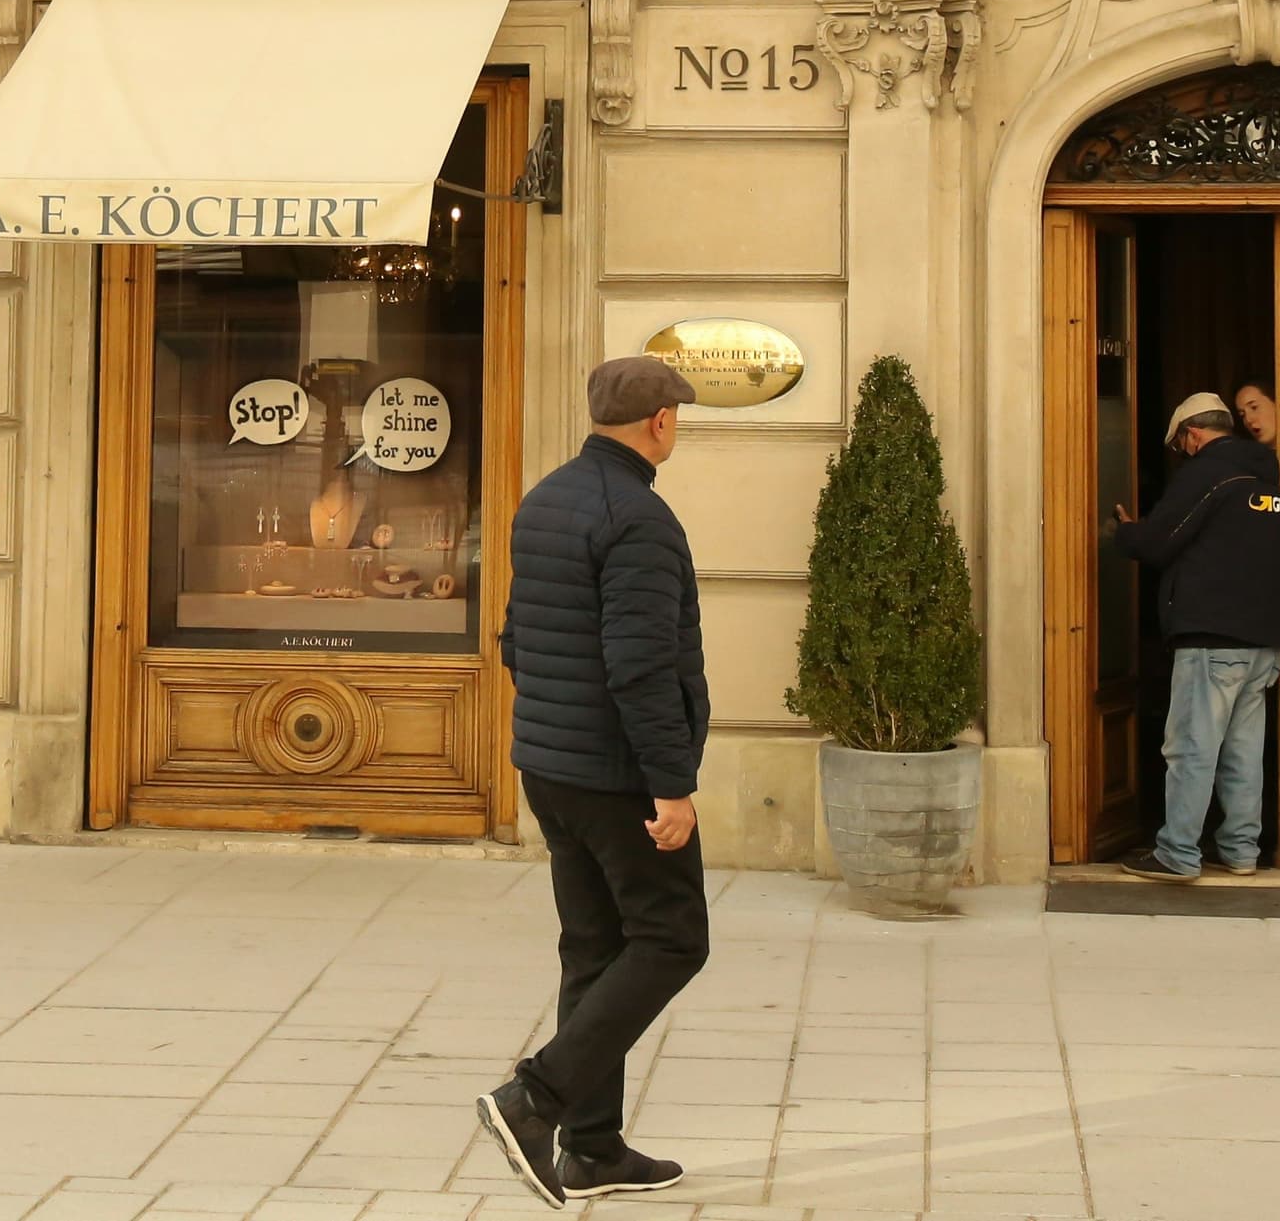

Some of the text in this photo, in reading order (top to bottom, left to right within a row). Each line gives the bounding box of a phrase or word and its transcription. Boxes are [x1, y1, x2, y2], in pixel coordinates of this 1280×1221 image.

[760, 44, 819, 91] 15
[38, 195, 80, 236] E.
[97, 186, 379, 238] KÖCHERT
[235, 391, 301, 435] Stop!
[380, 387, 440, 407] let me
[382, 409, 439, 432] shine
[374, 436, 438, 465] for you
